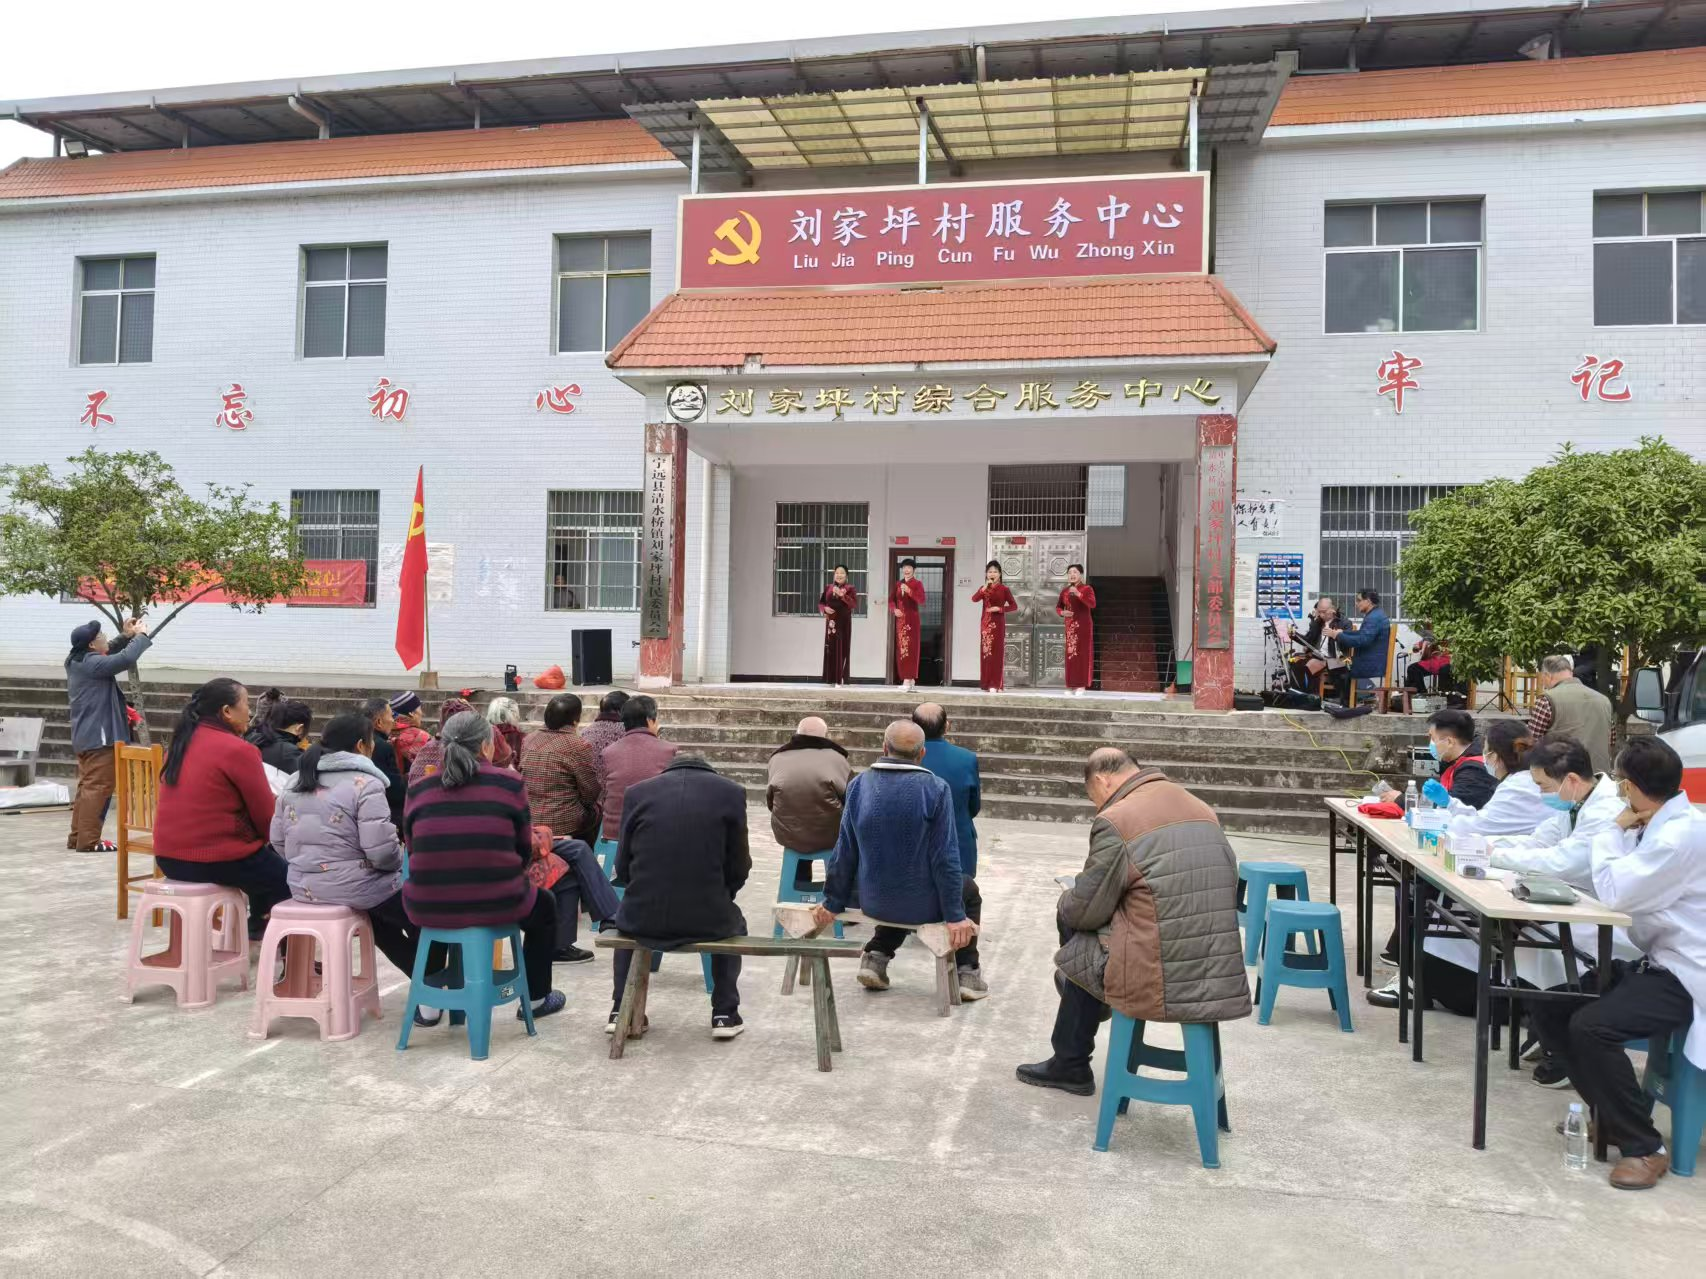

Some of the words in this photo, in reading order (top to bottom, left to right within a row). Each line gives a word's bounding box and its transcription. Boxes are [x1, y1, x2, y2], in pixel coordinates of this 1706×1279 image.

[788, 194, 1184, 247] 刘家坪村服务中心
[793, 254, 819, 269] Liu
[831, 253, 855, 267] Jia
[876, 251, 915, 268] Ping
[938, 248, 972, 264] Cun
[993, 247, 1015, 261] Fu
[1030, 245, 1059, 260] Wu
[1076, 243, 1135, 260] Zhong
[1142, 240, 1175, 256] Xin
[716, 376, 1221, 416] 刘家坪村综合服务中心
[649, 456, 666, 633] 宁远县清水桥镇刘家坪村民委员会
